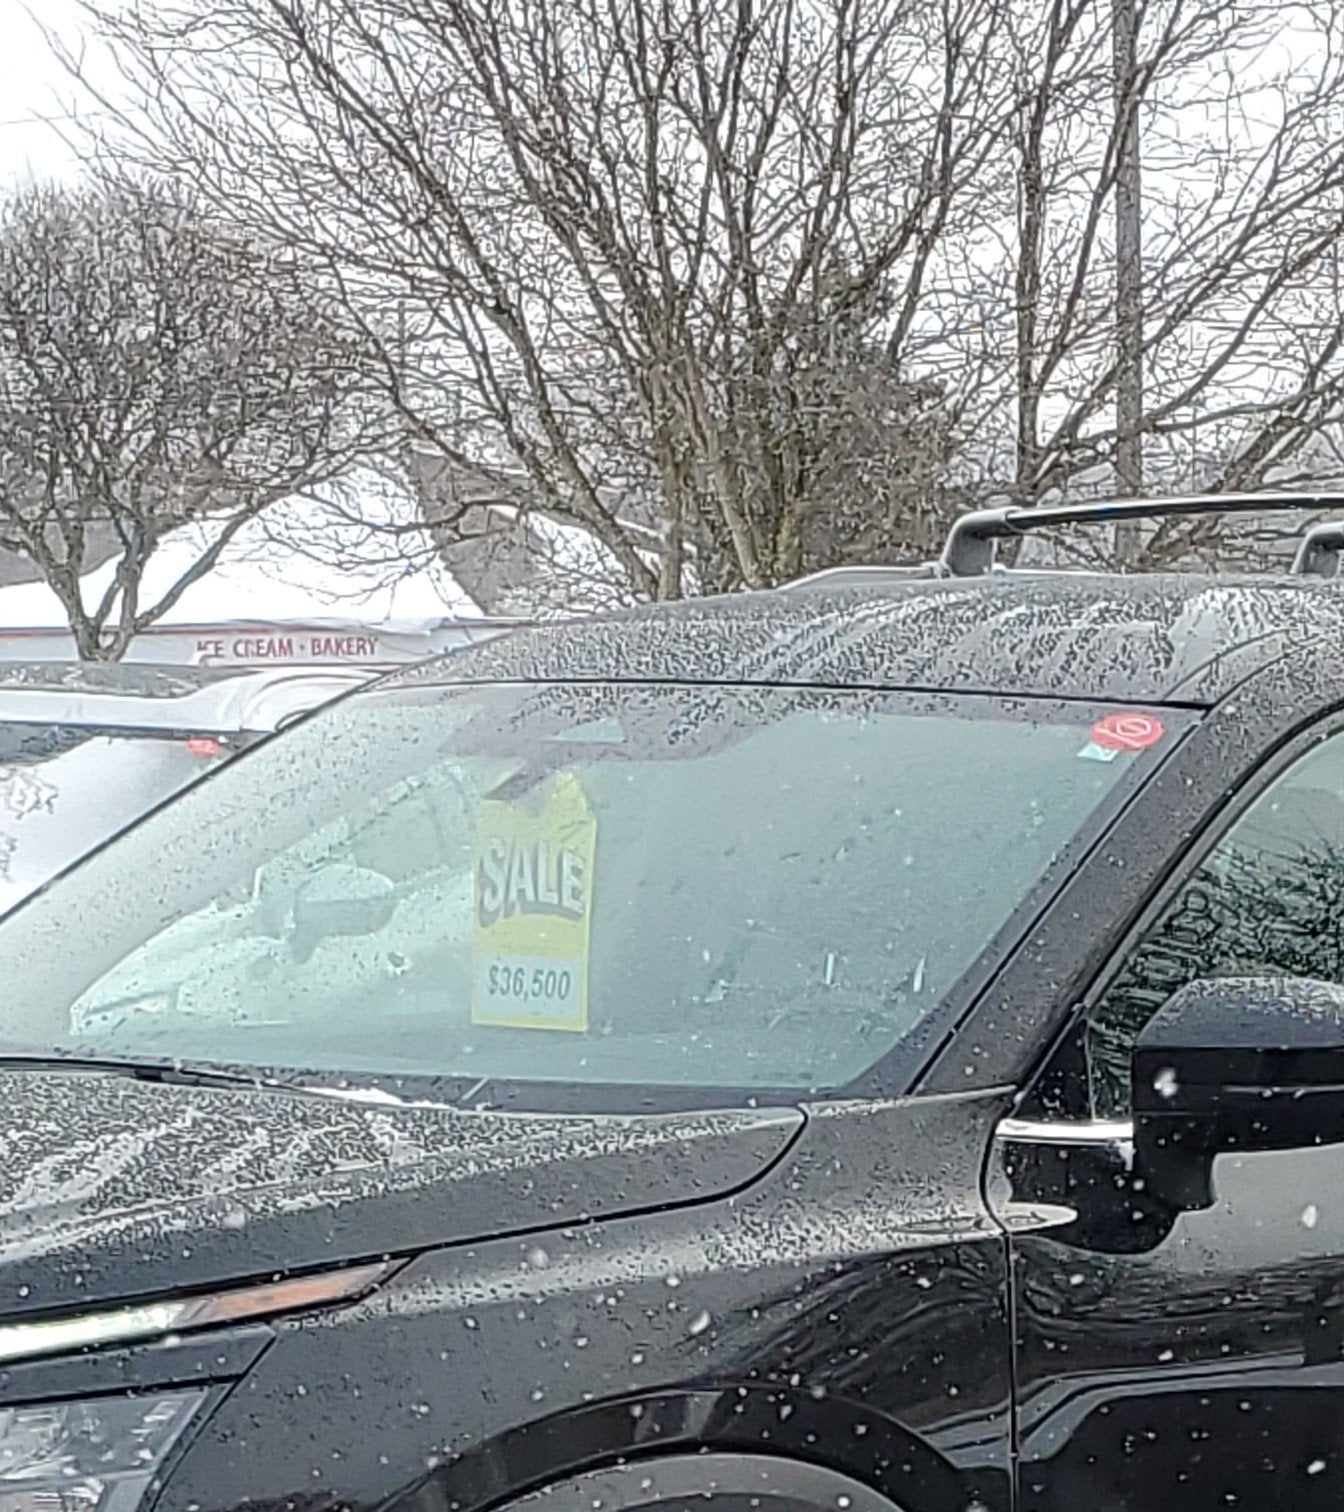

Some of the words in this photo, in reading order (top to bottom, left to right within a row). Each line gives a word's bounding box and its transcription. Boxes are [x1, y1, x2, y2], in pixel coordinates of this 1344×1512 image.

[233, 638, 294, 658] CREAM
[311, 636, 377, 656] BAKERY
[479, 838, 584, 929] SALE
[489, 965, 571, 1000] $36,500
